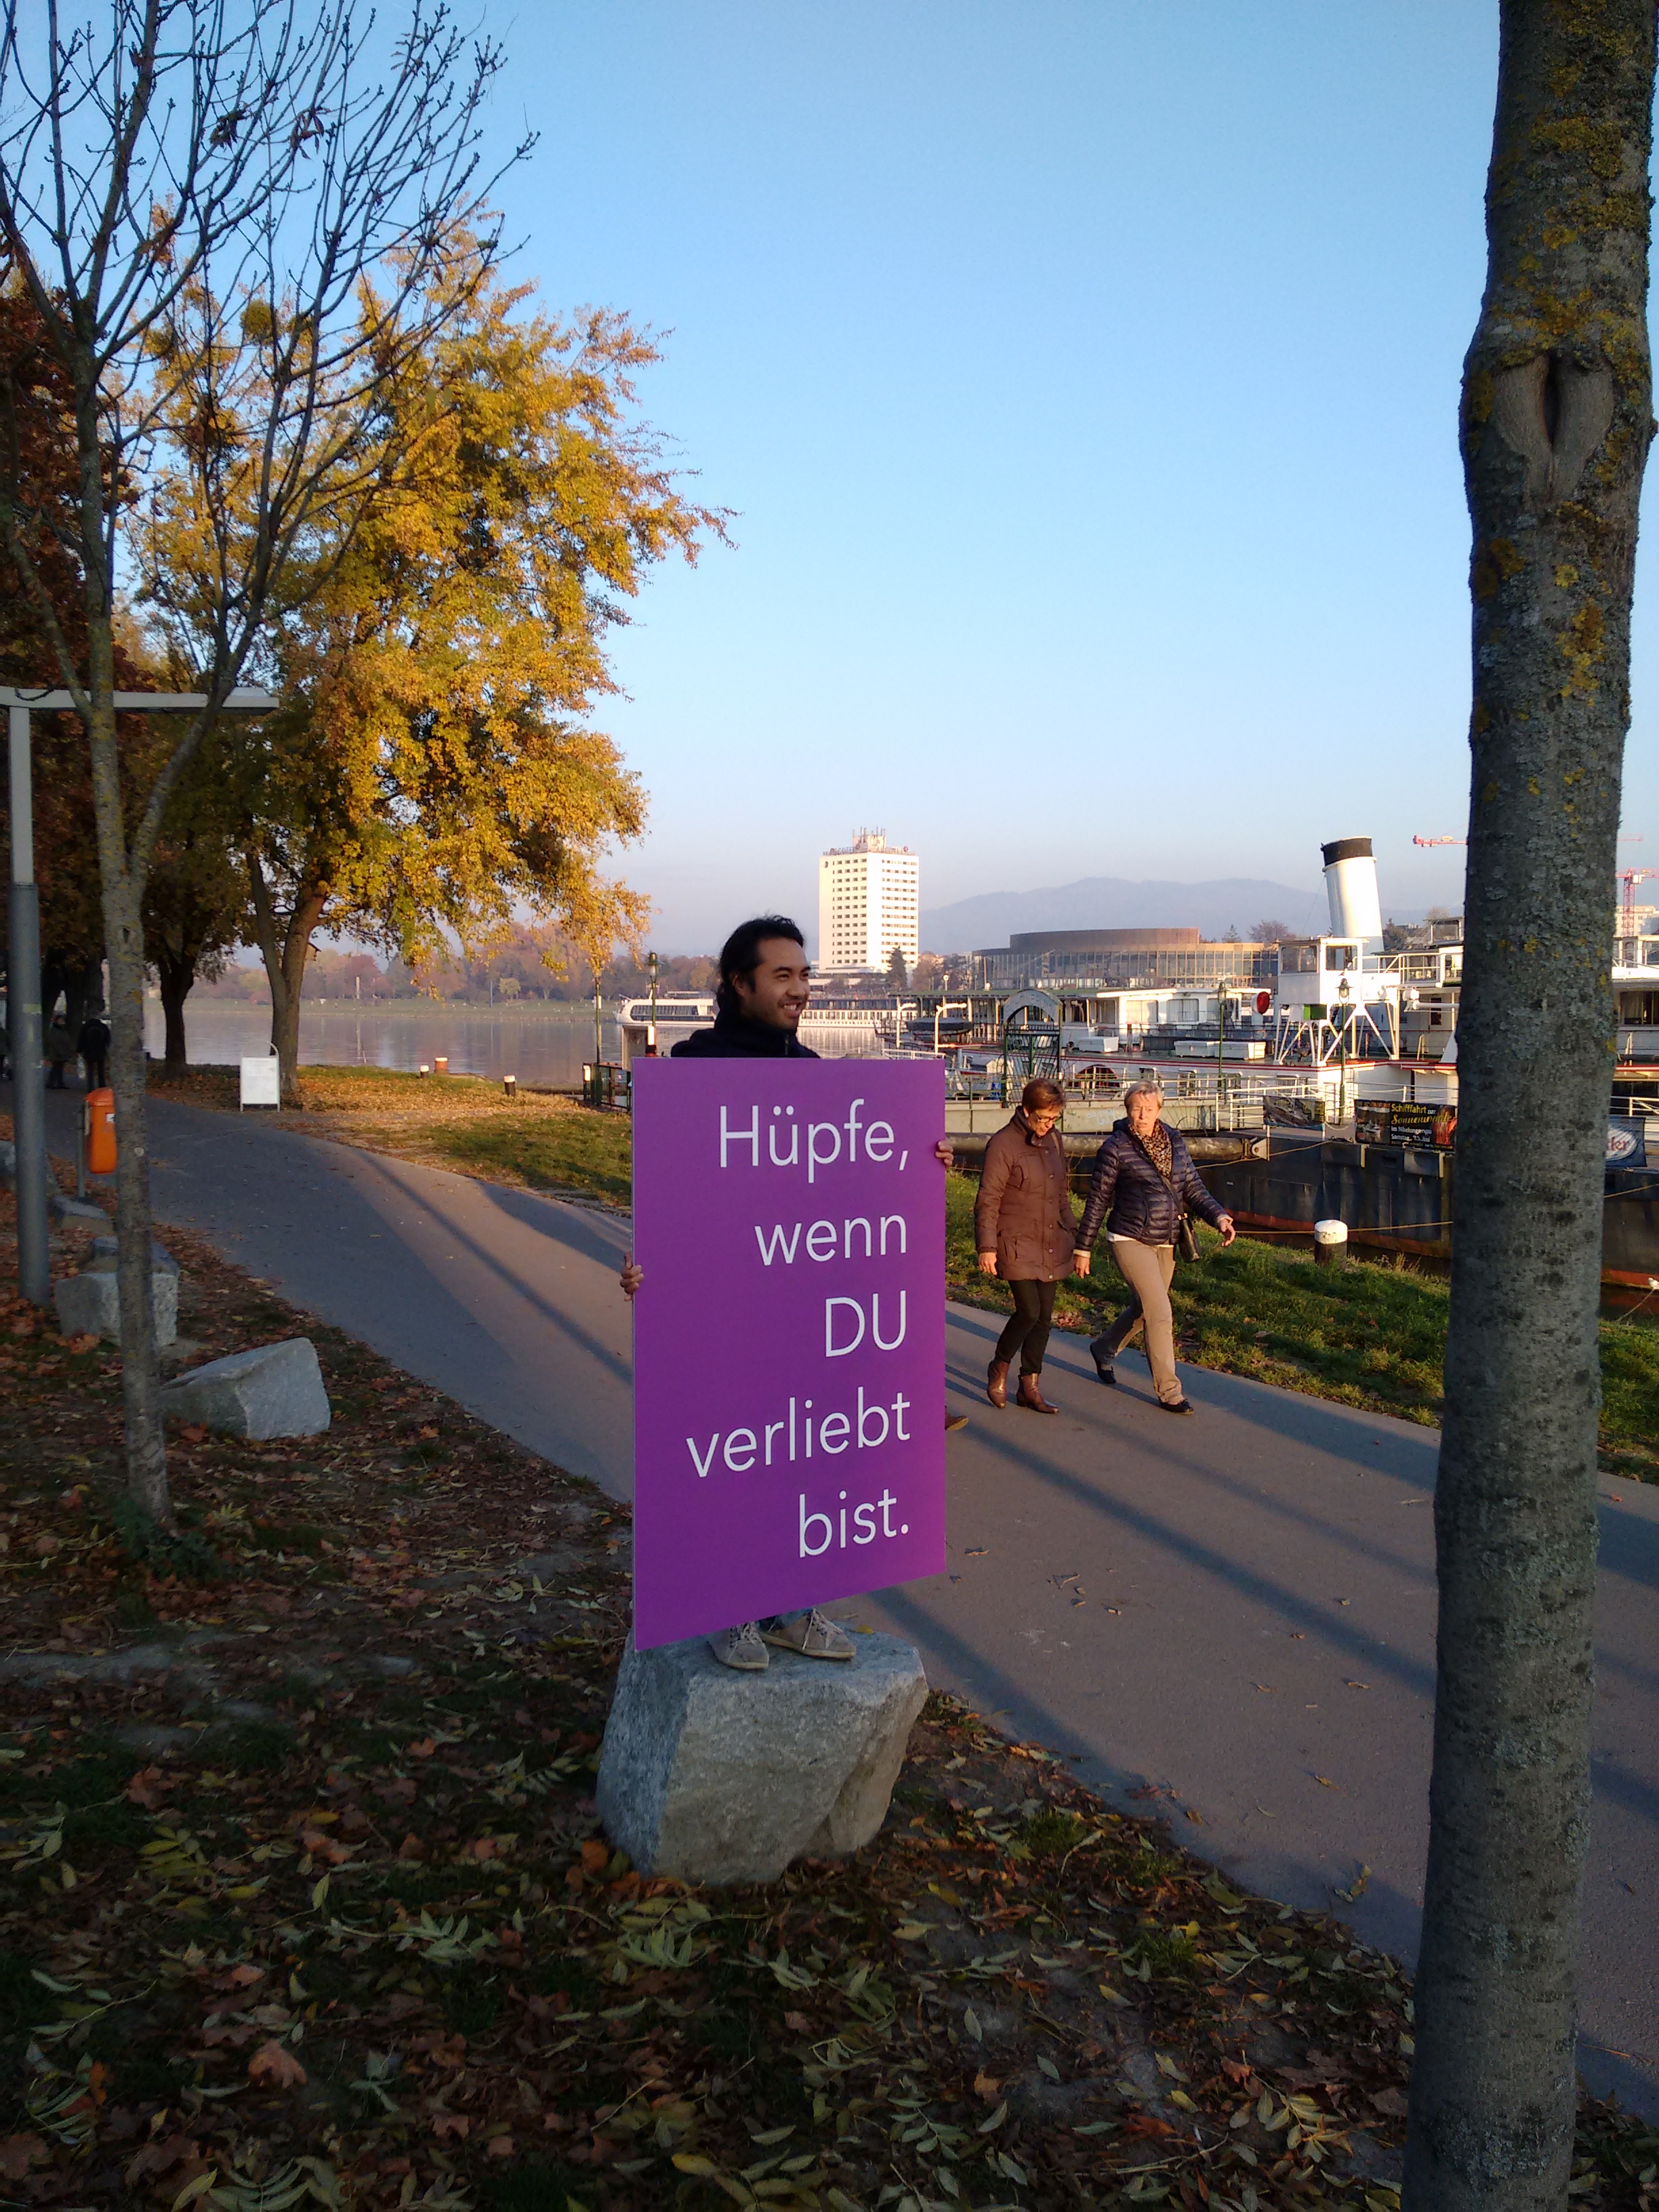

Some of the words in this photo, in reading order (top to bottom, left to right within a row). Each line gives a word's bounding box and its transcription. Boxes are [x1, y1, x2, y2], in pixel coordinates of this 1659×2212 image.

[720, 1098, 909, 1184] Hüpfe,
[1391, 1103, 1427, 1113] Schifffahrt
[754, 1214, 907, 1266] wenn
[825, 1290, 906, 1357] DU
[686, 1386, 910, 1478] verliebt
[799, 1488, 909, 1558] bist.
